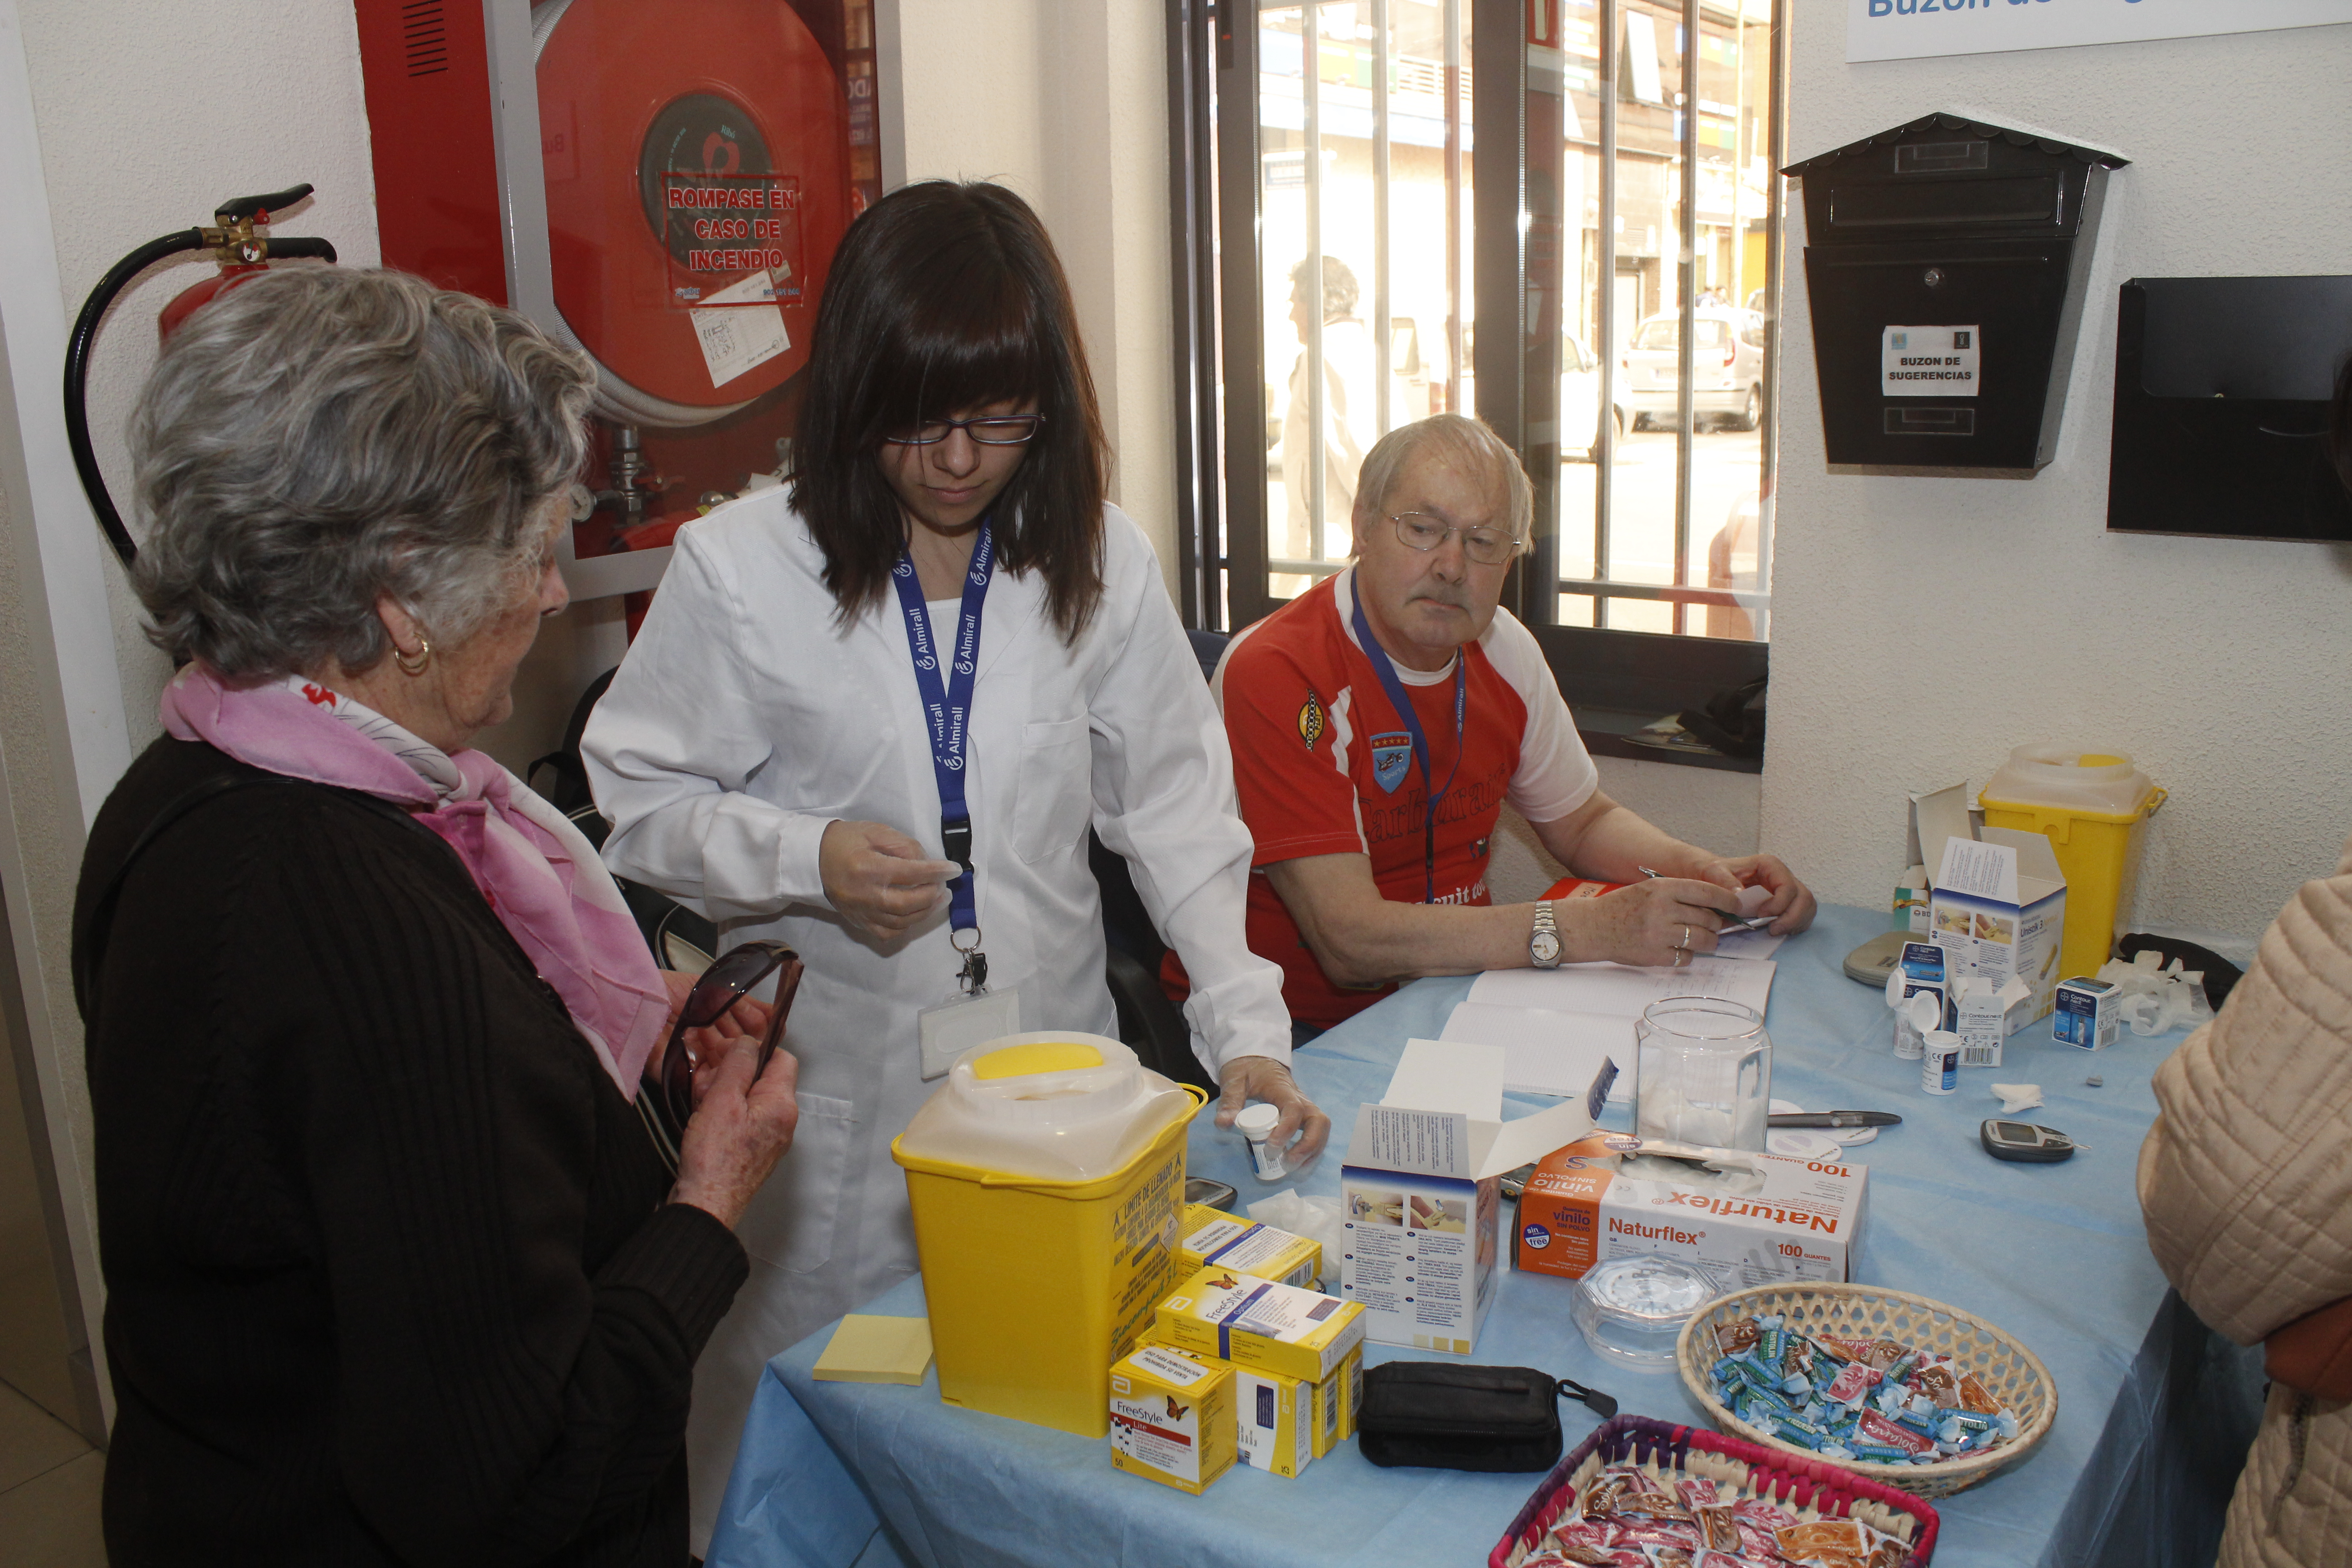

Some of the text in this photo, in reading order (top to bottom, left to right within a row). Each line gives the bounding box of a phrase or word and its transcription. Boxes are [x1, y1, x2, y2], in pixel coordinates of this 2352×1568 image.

[668, 188, 794, 209] ROMPASE EN
[695, 219, 780, 239] CASO DE
[690, 249, 783, 270] INCENDIO
[1901, 357, 1960, 365] BUZON DE
[1889, 372, 1971, 380] SUGERENCIAS
[976, 528, 992, 572] Almirall
[909, 608, 929, 653] Almirall
[961, 614, 975, 659] Almirall
[930, 703, 944, 749] lmirall
[949, 706, 963, 754] Almirall
[1382, 765, 1406, 781] Sports
[2070, 994, 2092, 1004] Contour
[1565, 1156, 1589, 1170] S
[1758, 1154, 1851, 1178] 100 GUANTES
[1143, 1183, 1150, 1202] DE
[1151, 1161, 1172, 1195] LLENADO
[1534, 1179, 1594, 1193] vinilo
[1553, 1211, 1590, 1225] vinilo
[1241, 1225, 1261, 1239] Optium
[1569, 1224, 1590, 1232] POLVO
[1778, 1243, 1831, 1262] 100 GUANTES
[1206, 1289, 1247, 1320] FreeStyle
[1234, 1298, 1254, 1315] Optium
[1143, 1357, 1166, 1372] PROHIBIDA
[1174, 1371, 1188, 1380] VENTA
[1156, 1355, 1167, 1364] PARA
[1117, 1401, 1163, 1425] FreeStyle
[1133, 1421, 1147, 1430] Lite
[1871, 1425, 1919, 1456] Solano
[1115, 1458, 1123, 1467] 50
[1281, 1465, 1289, 1474] 25
